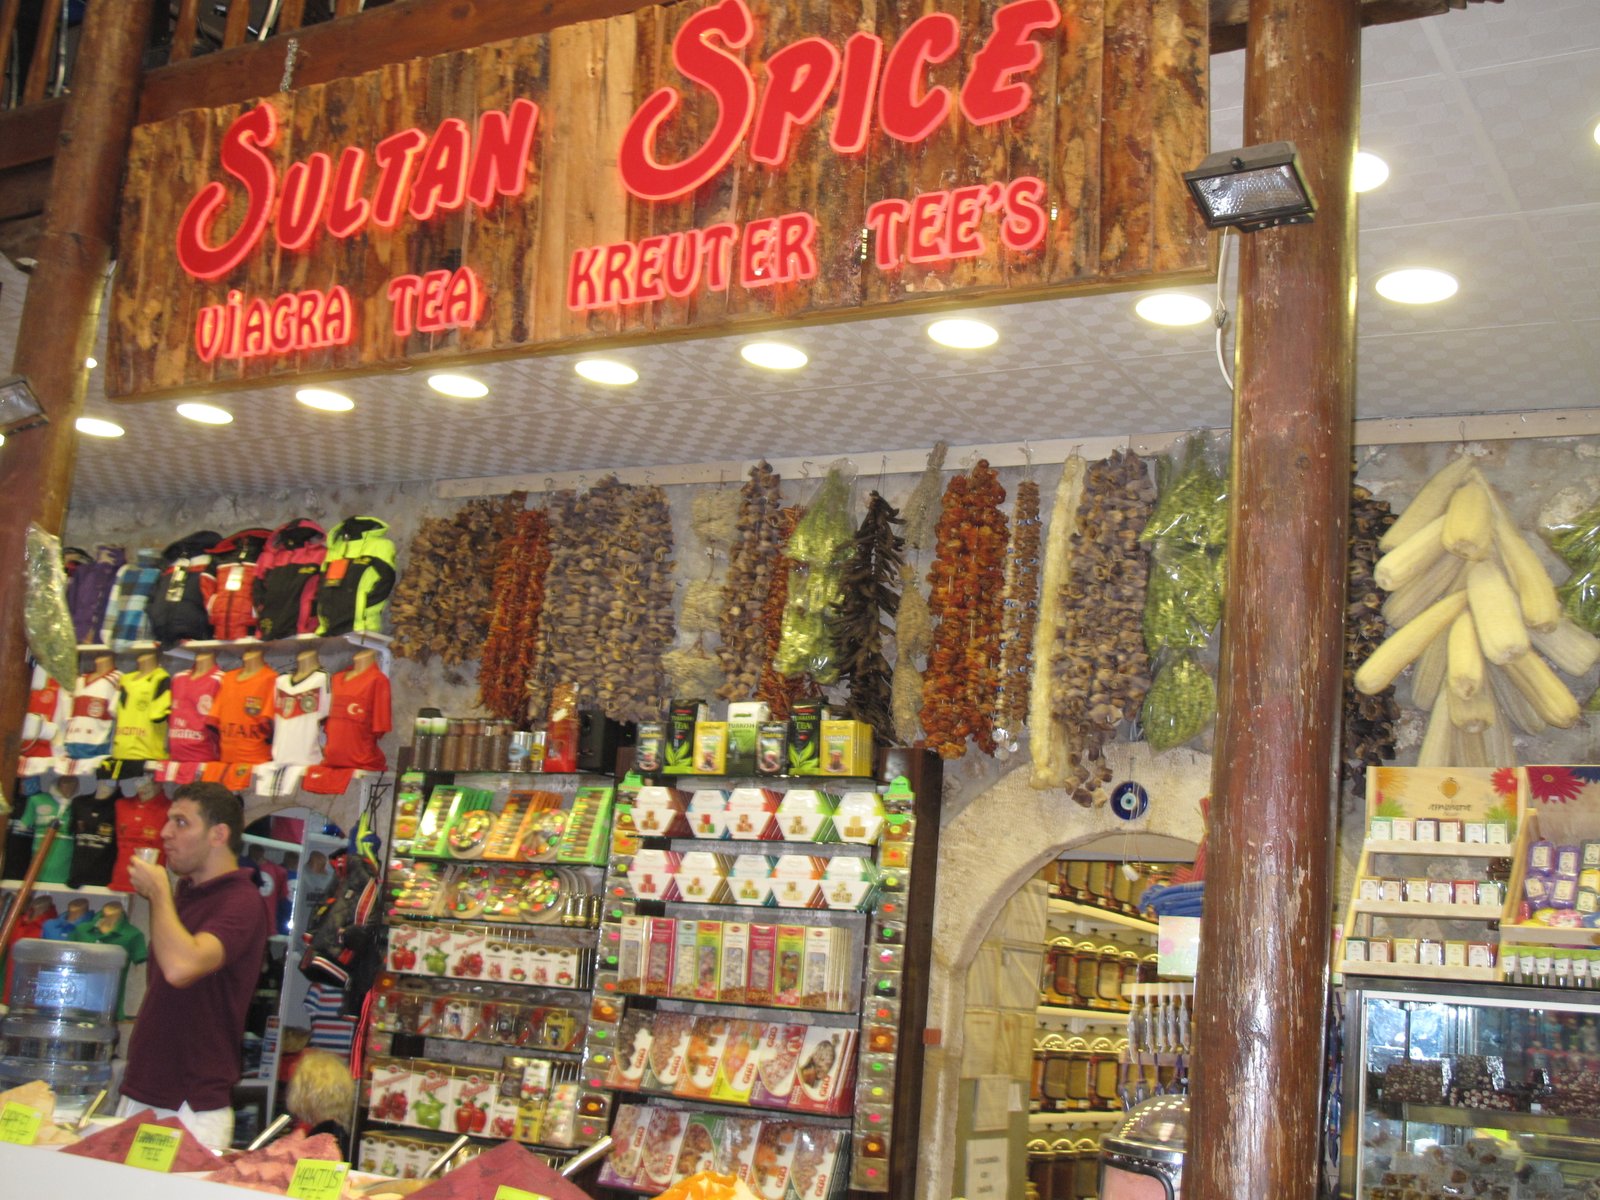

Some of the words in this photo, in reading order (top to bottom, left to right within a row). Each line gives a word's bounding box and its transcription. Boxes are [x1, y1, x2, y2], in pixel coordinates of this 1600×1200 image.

[177, 99, 539, 279] SULTAN
[618, 0, 1062, 200] SPICE
[386, 265, 481, 337] TEA
[567, 211, 817, 313] KREUTER
[867, 176, 1048, 269] TEE'S
